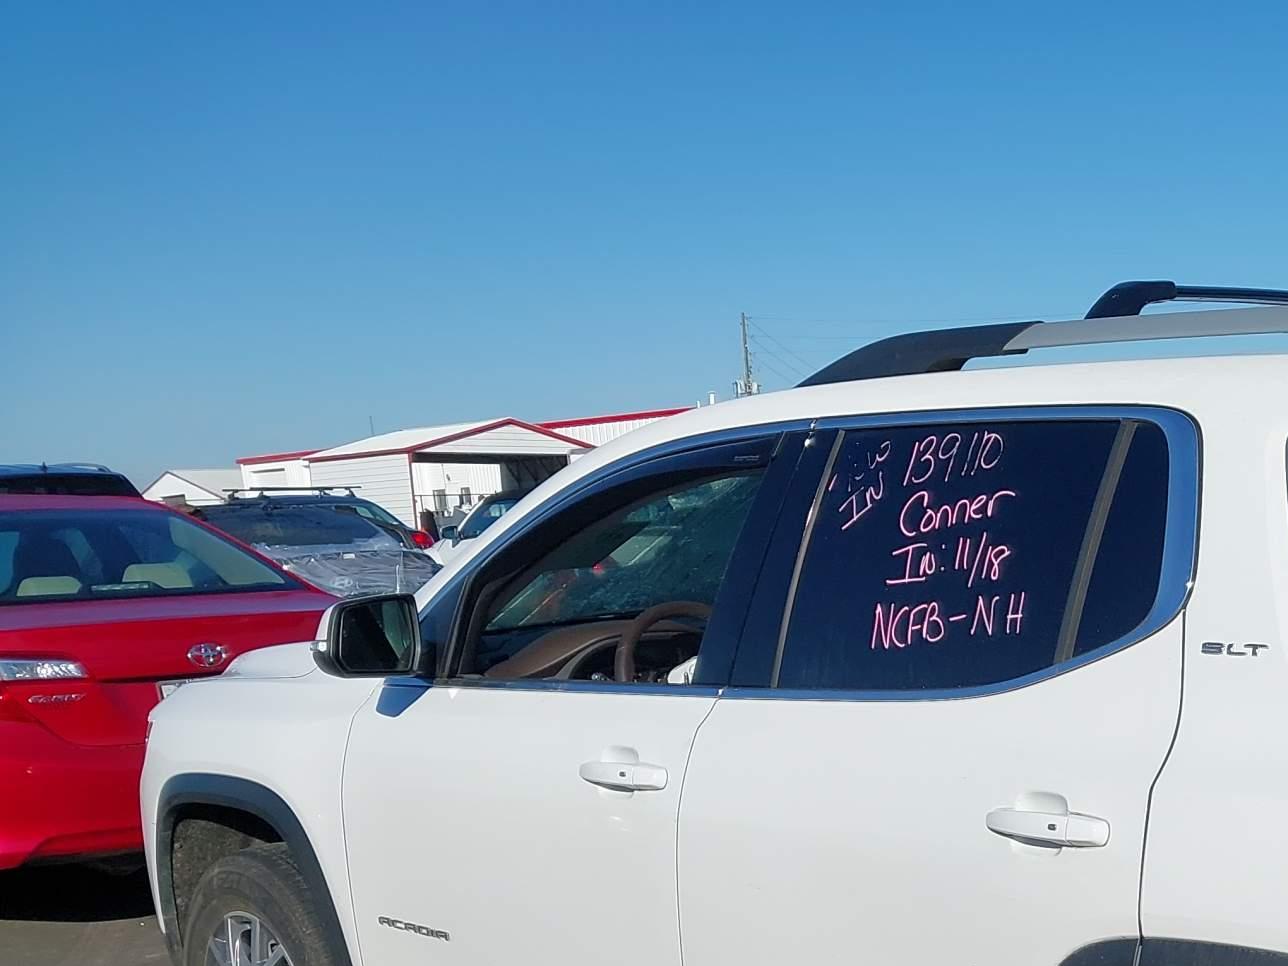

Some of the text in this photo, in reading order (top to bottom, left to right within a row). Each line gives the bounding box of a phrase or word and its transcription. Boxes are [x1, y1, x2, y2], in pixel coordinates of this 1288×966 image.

[900, 490, 1016, 537] Conner
[954, 531, 1011, 588] 11/18
[1200, 641, 1269, 657] SLT
[378, 916, 449, 941] ACADIA
